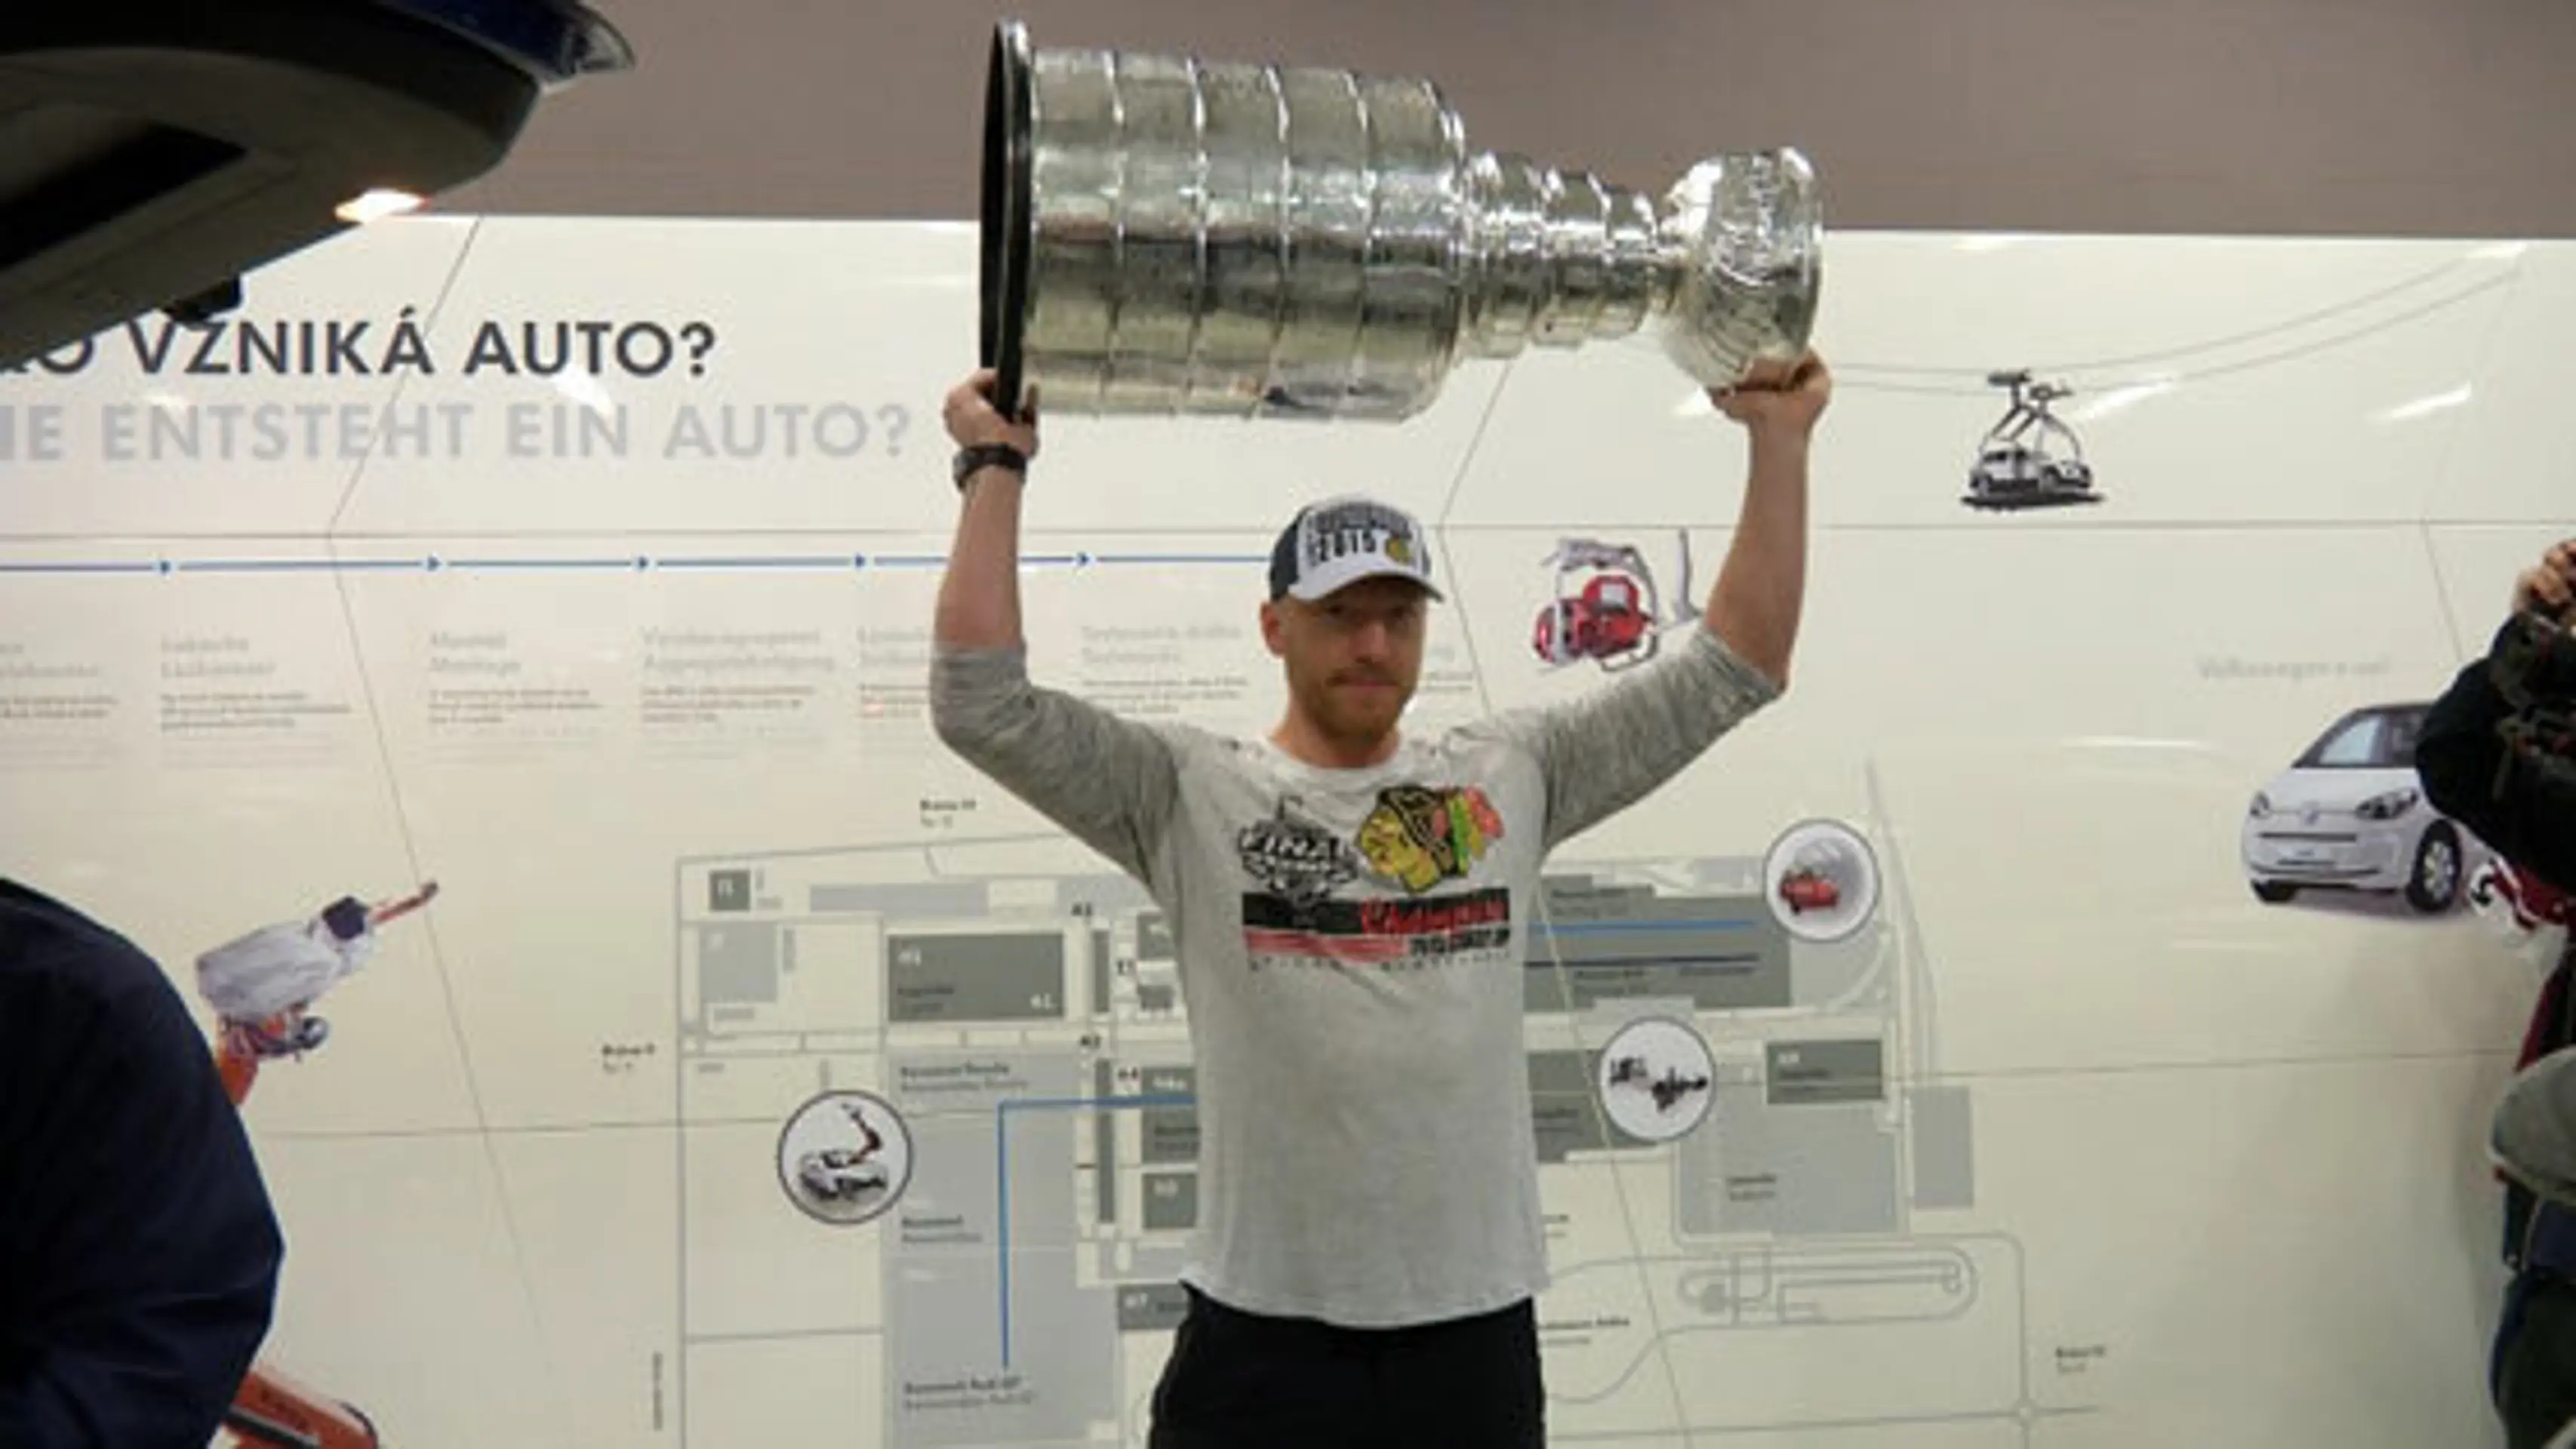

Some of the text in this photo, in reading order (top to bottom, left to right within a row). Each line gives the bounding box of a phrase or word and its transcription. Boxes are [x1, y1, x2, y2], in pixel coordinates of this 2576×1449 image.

[128, 307, 435, 375] VZNIKÁ
[463, 320, 717, 376] AUTO?
[101, 402, 474, 460] ENTSTEHT
[506, 402, 629, 457] EIN
[663, 401, 911, 457] AUTO?
